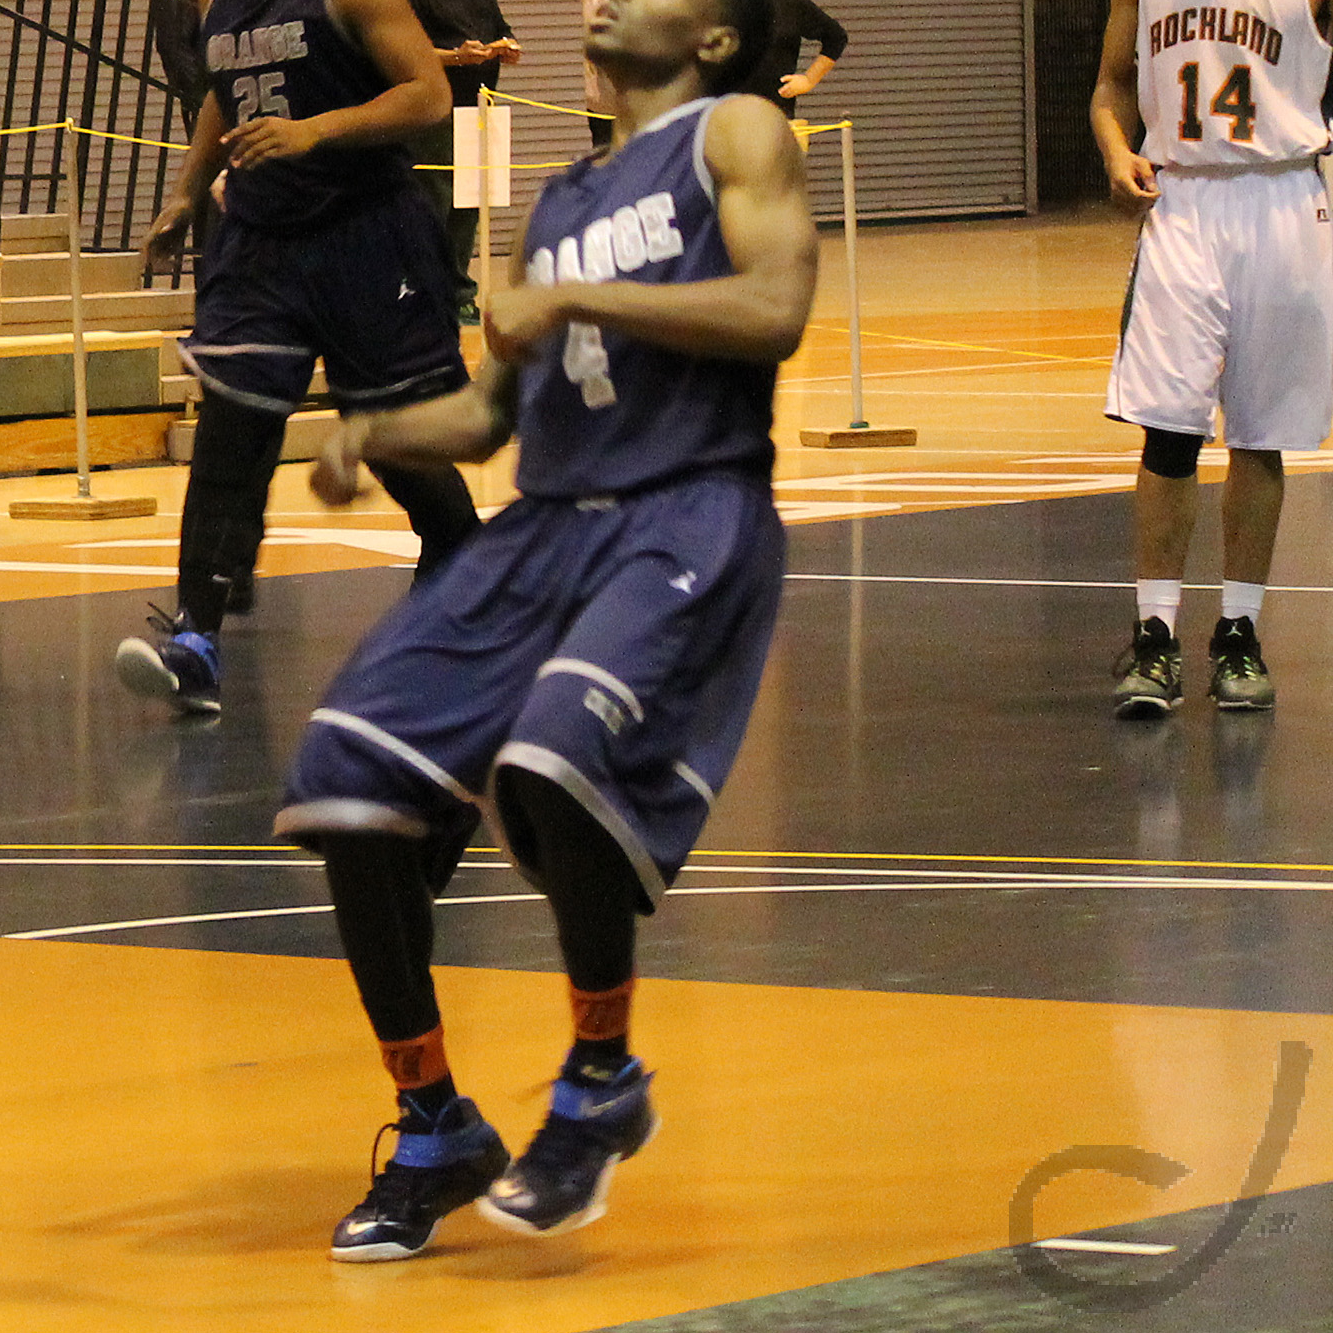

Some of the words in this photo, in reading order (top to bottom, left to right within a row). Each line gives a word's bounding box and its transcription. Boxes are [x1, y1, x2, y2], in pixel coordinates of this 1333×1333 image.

[207, 20, 309, 72] ORANGE
[1150, 6, 1283, 66] ROCKLAND
[232, 71, 293, 127] 25
[1178, 61, 1257, 143] 14
[525, 191, 684, 288] RANGE
